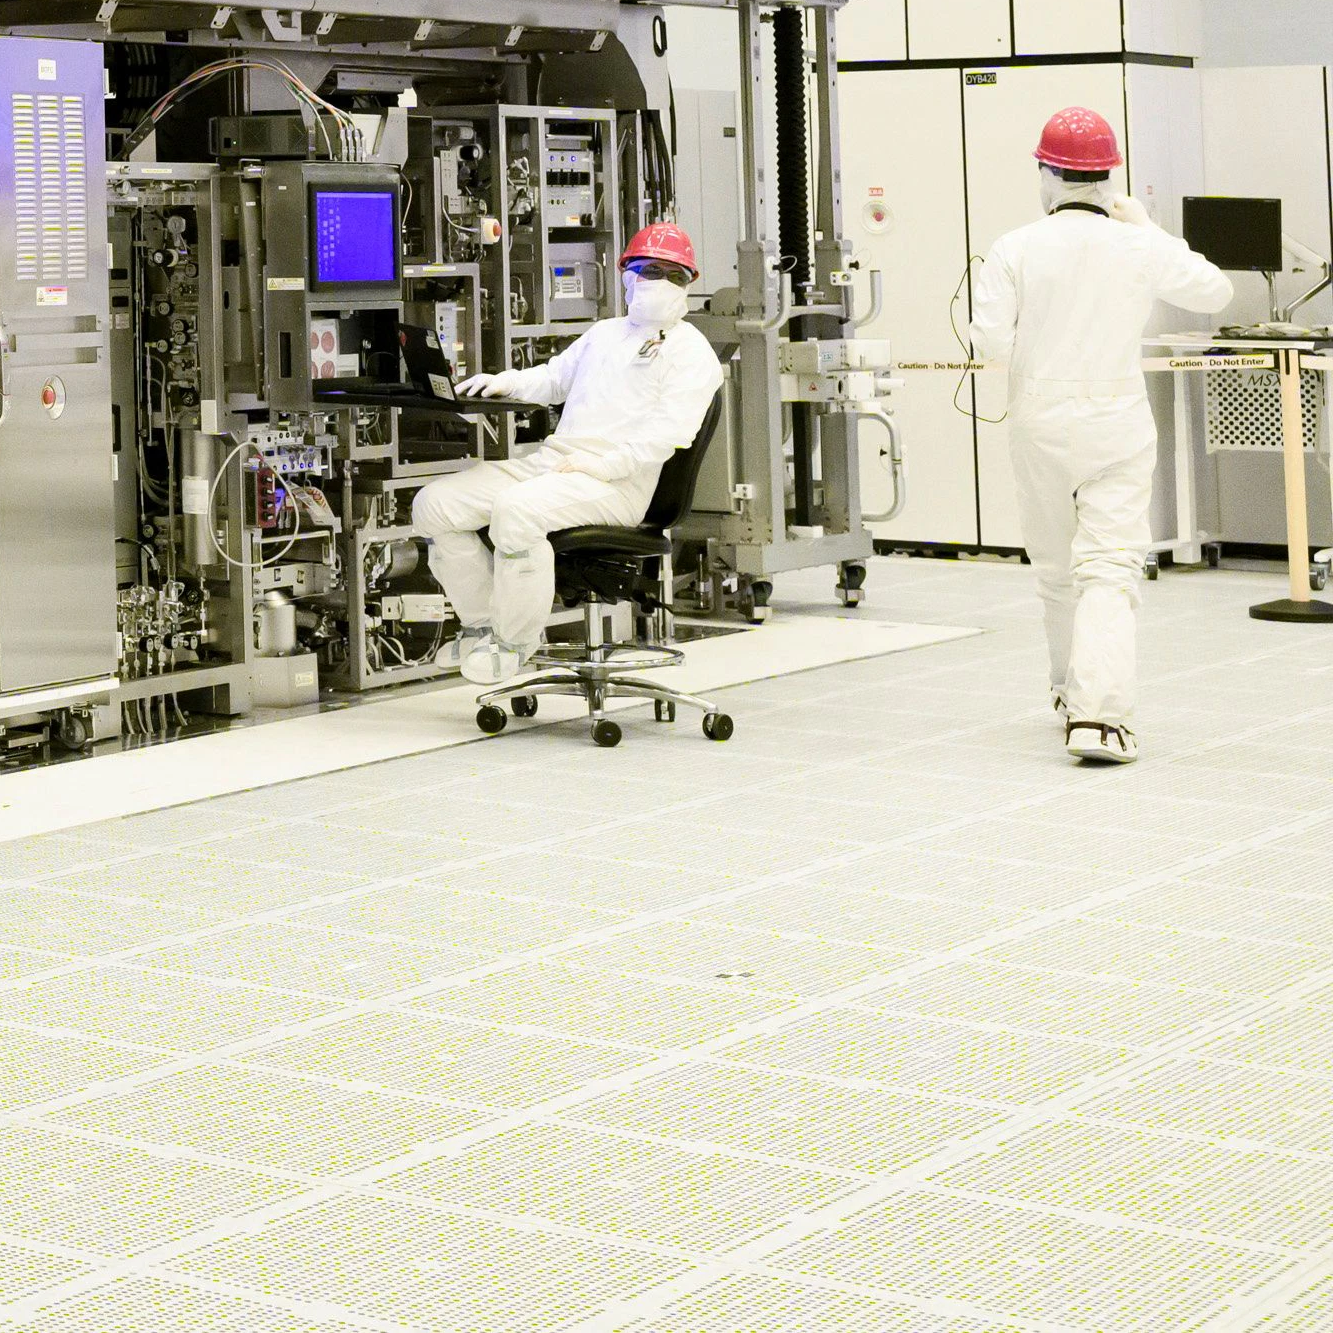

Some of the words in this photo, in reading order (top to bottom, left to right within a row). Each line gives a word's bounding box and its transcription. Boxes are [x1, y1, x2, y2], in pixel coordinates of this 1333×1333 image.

[1209, 358, 1222, 366] Do
[1223, 358, 1239, 366] Not
[1242, 357, 1265, 365] Enter
[898, 362, 929, 370] Caution
